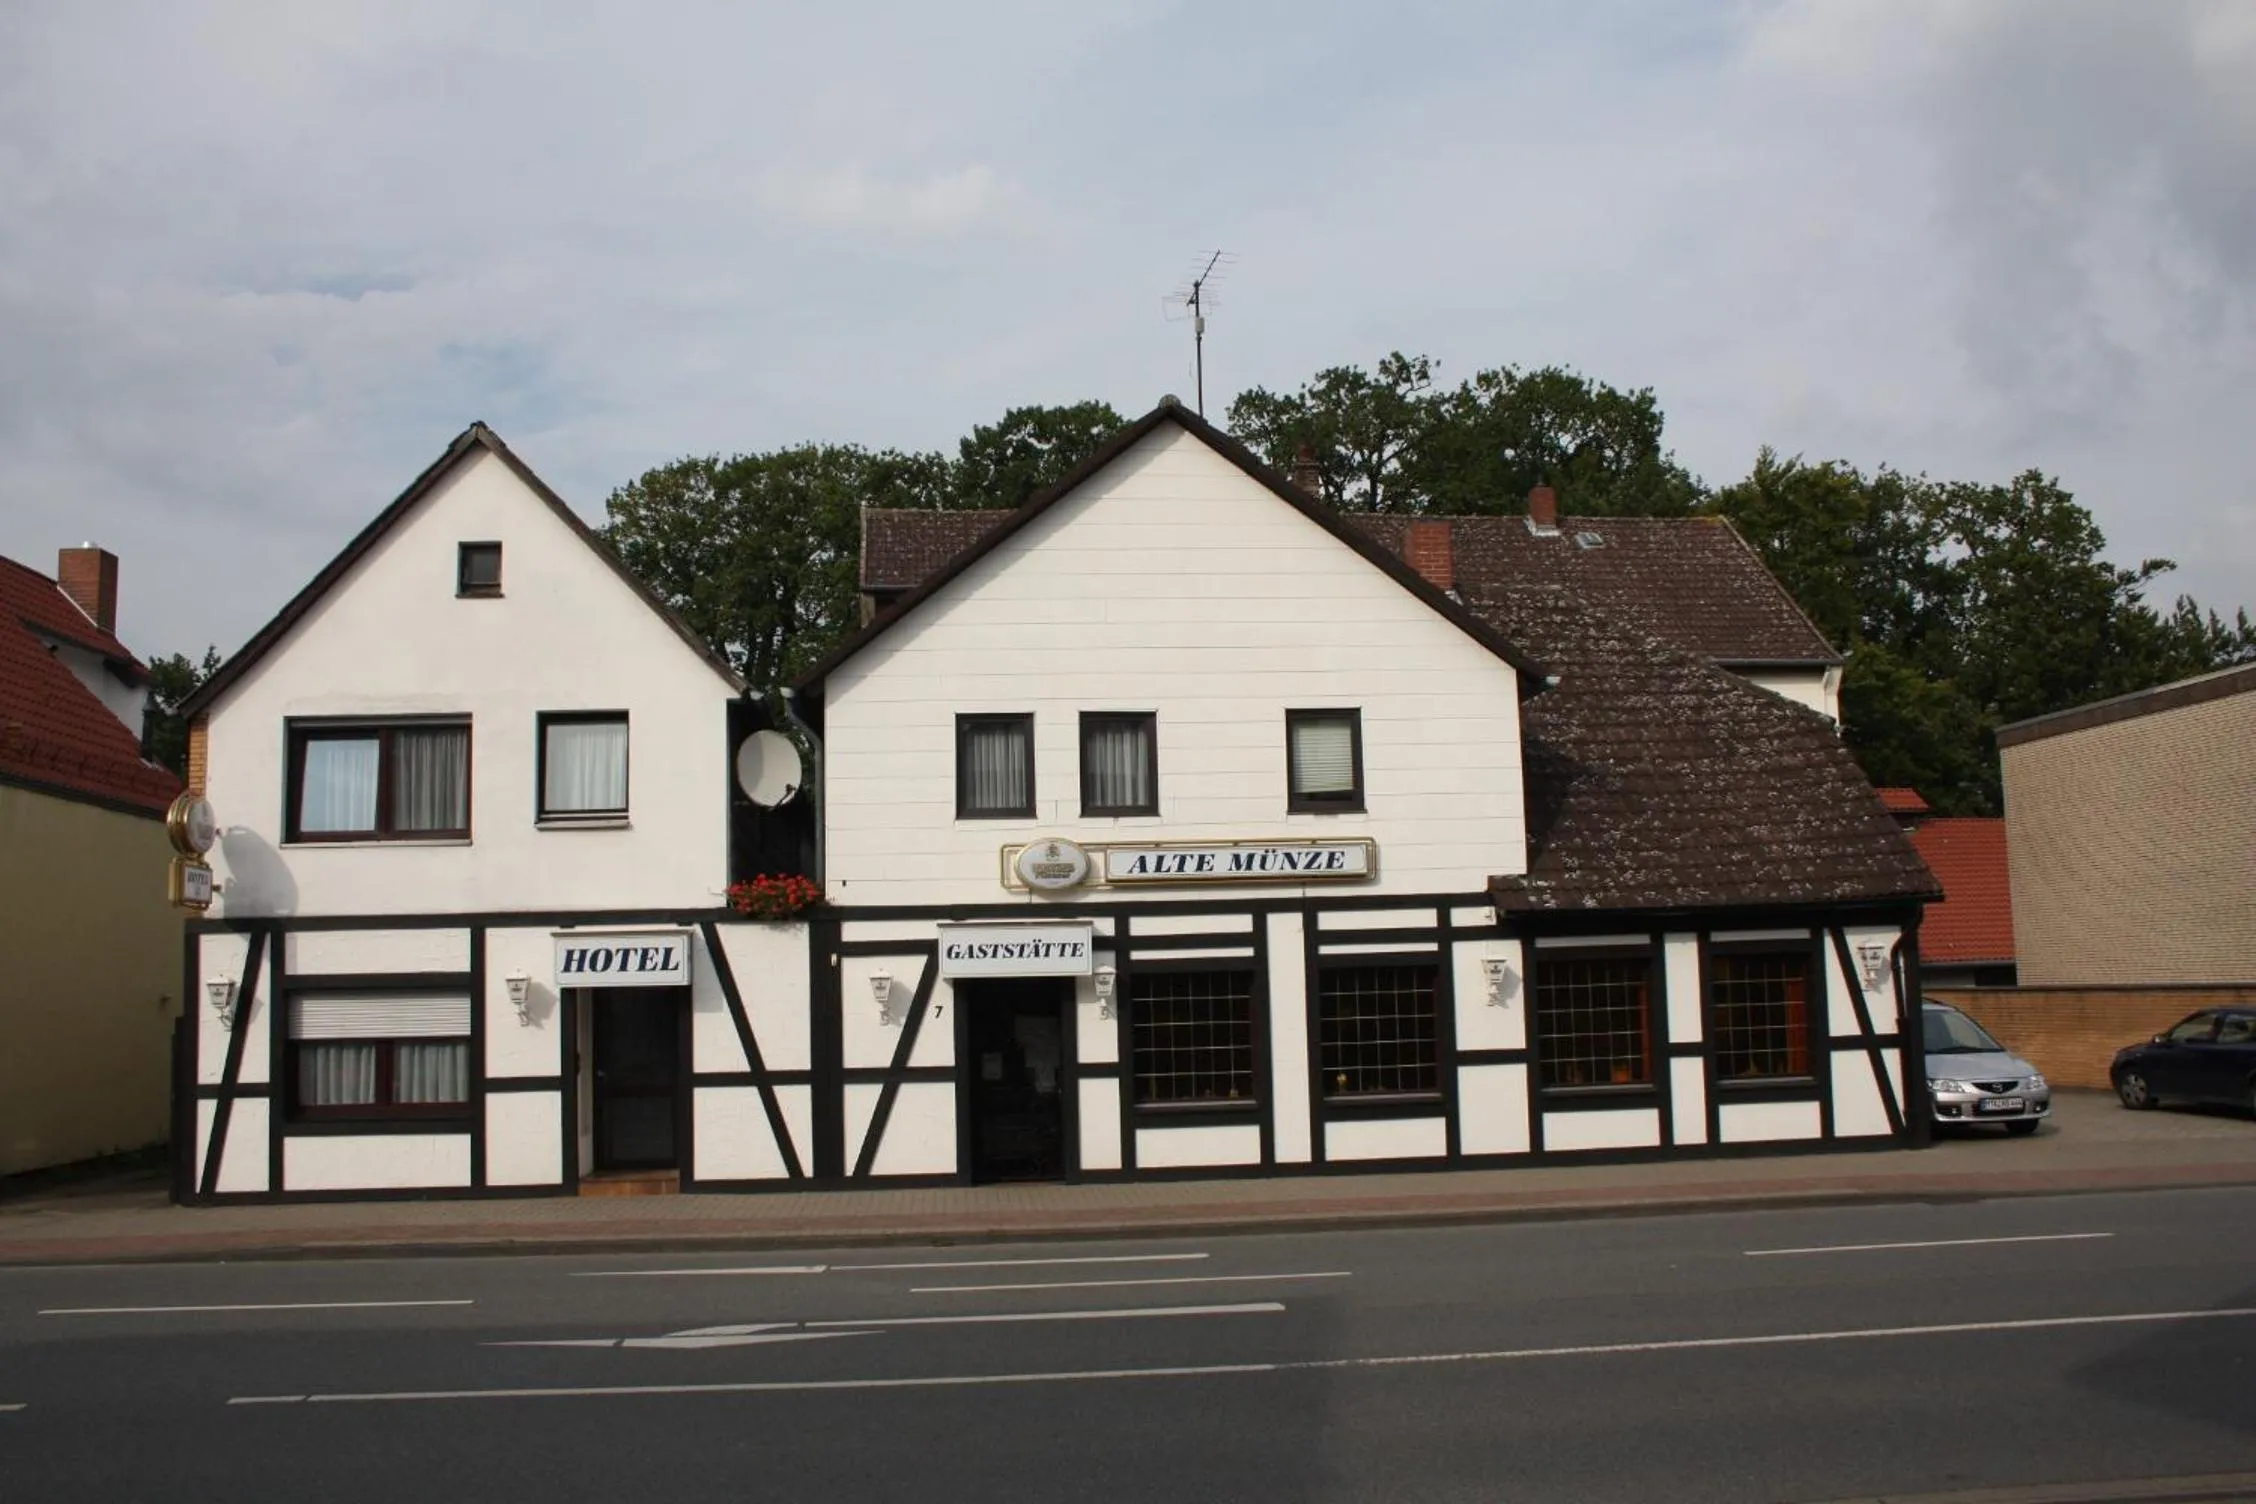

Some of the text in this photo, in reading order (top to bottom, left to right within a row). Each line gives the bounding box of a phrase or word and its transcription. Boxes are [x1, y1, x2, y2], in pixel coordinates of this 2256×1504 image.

[1127, 848, 1346, 874] ALTE MÜNZE
[560, 946, 681, 974] HOTEL
[946, 939, 1085, 961] GASTSTÄTTE
[934, 1005, 945, 1019] 7
